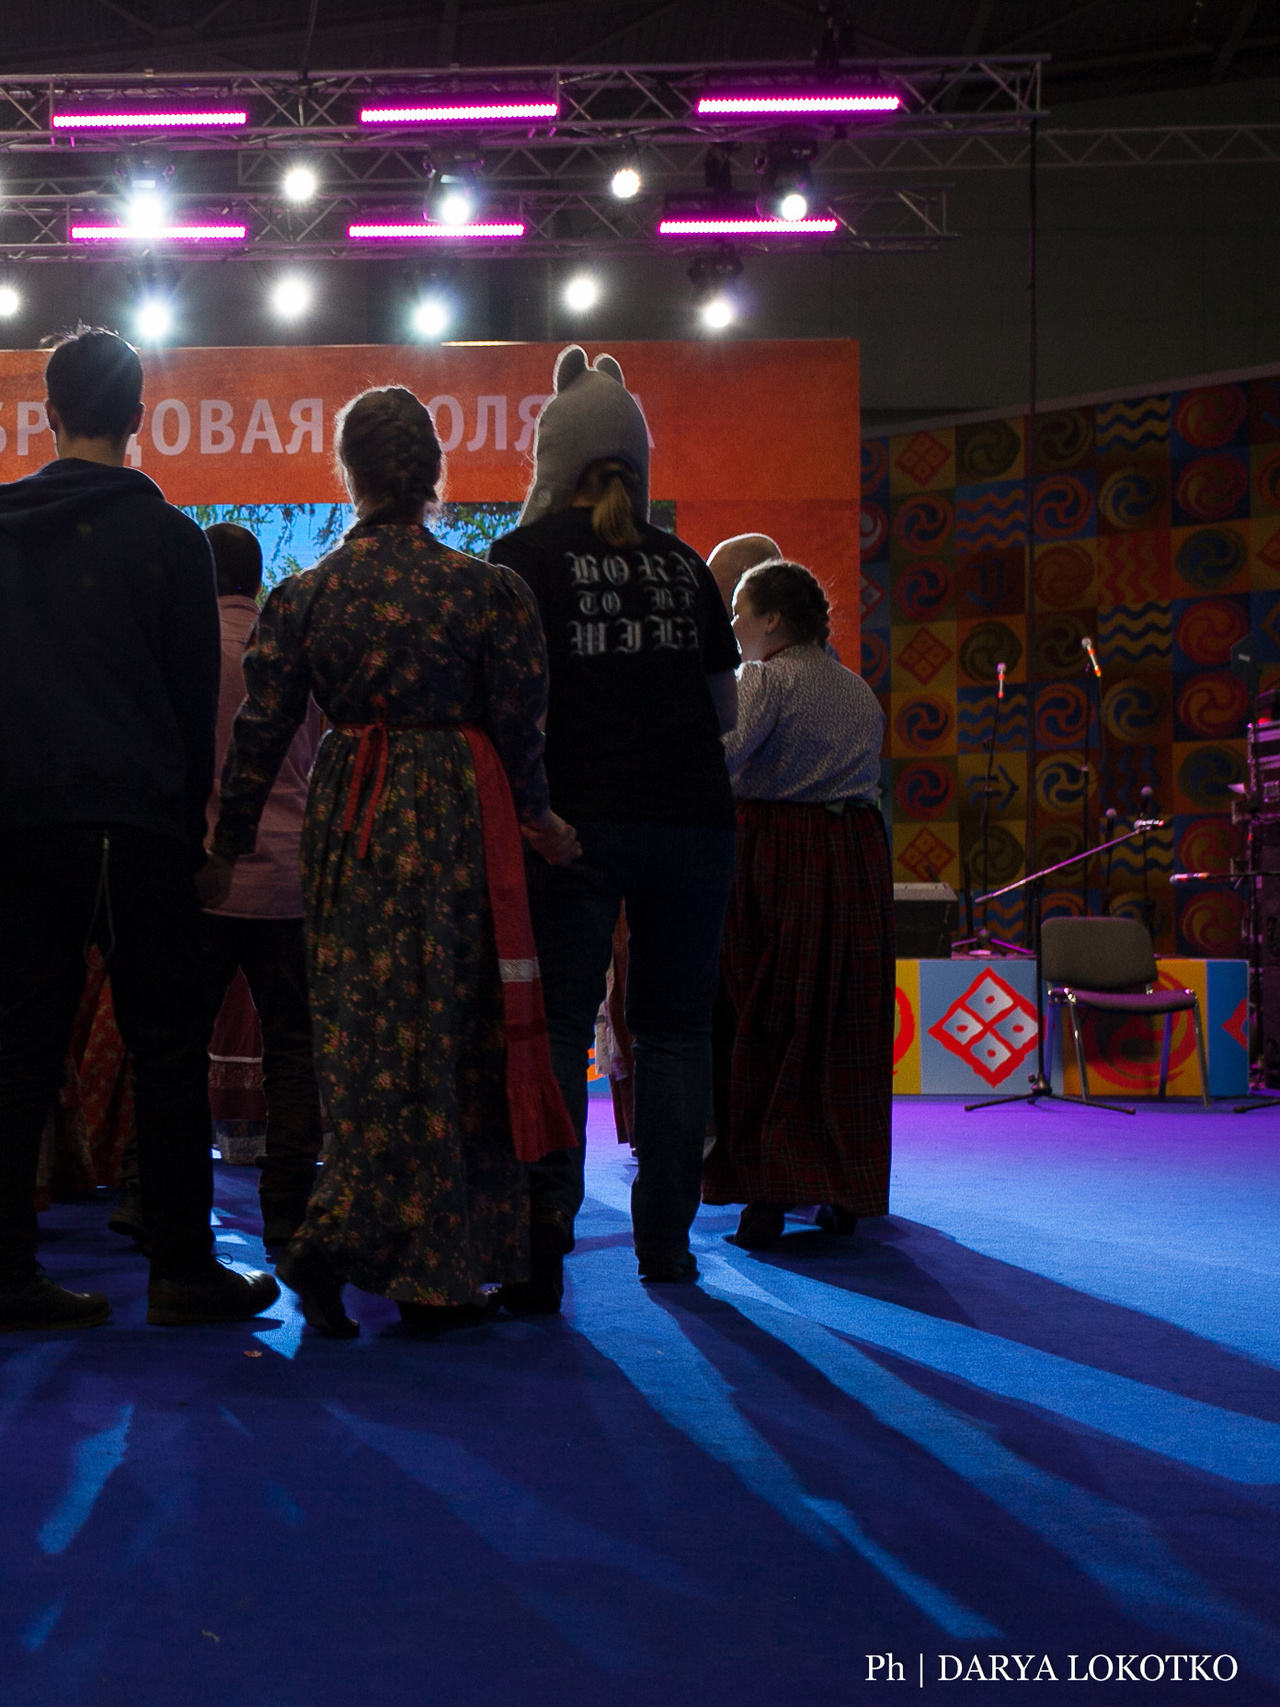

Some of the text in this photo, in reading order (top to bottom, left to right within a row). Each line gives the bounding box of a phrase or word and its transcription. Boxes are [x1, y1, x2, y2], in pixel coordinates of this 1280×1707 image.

[383, 393, 656, 452] ОЛЯ
[565, 551, 700, 587] BORN
[576, 589, 622, 616] TO
